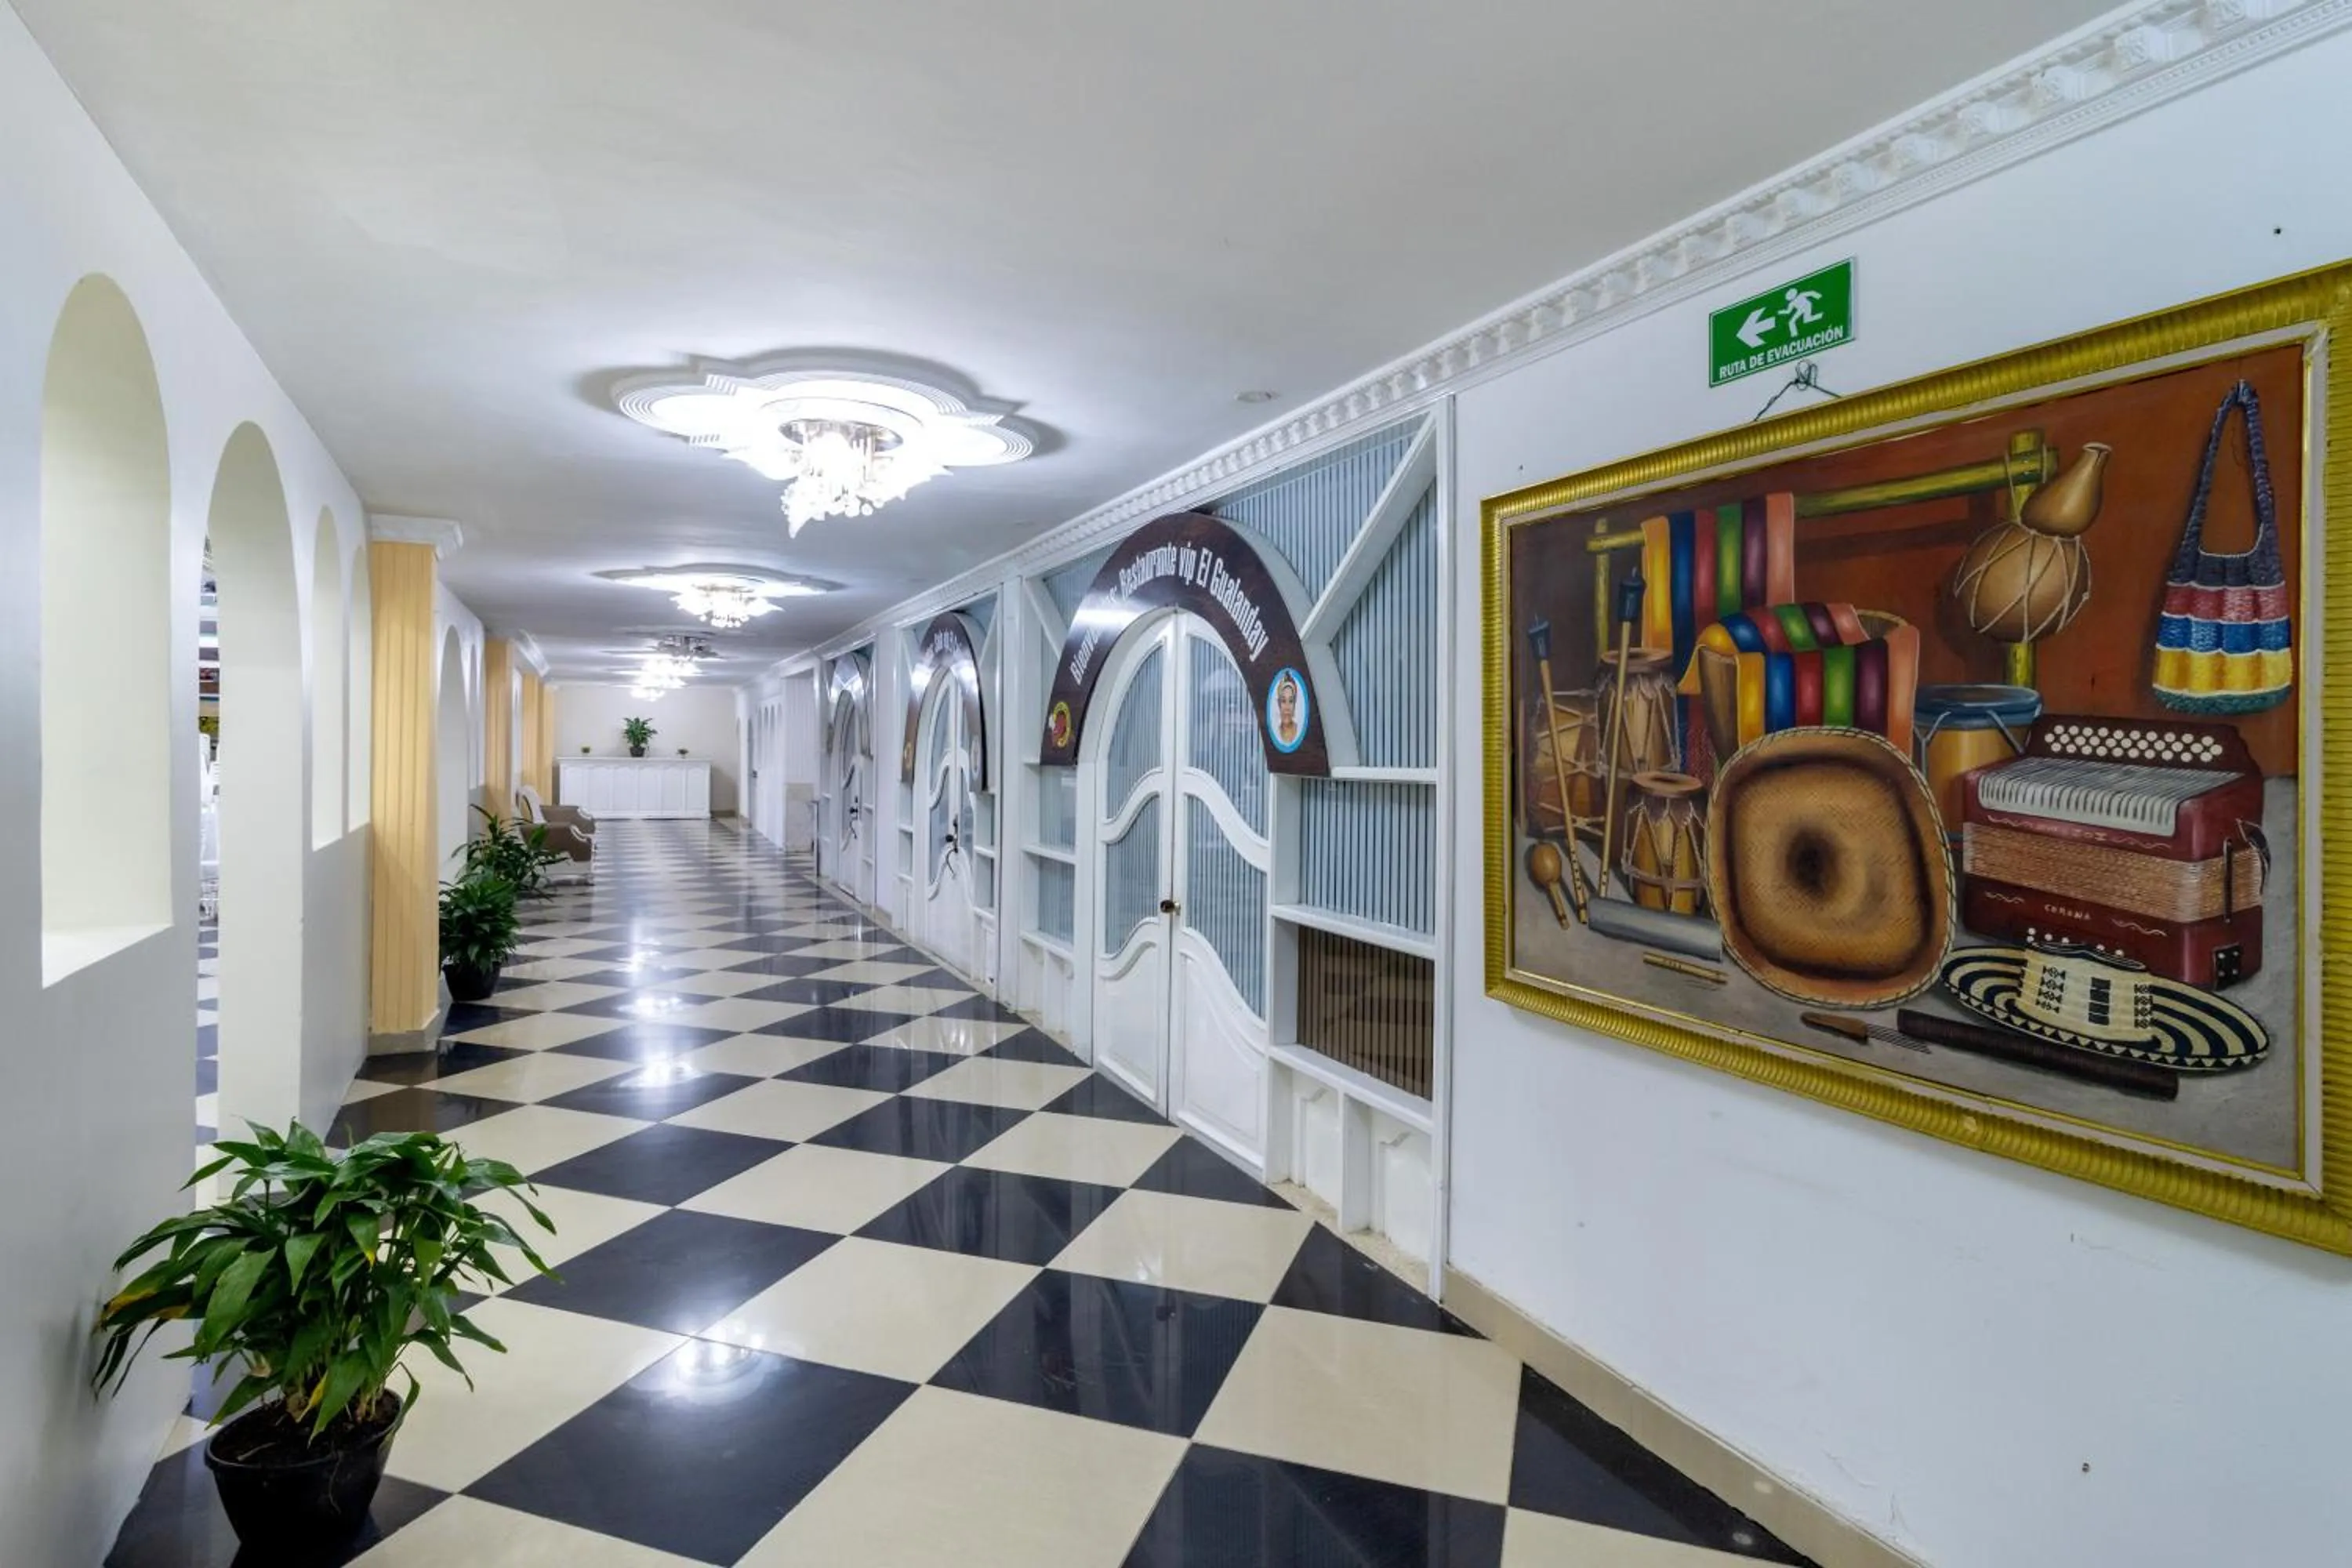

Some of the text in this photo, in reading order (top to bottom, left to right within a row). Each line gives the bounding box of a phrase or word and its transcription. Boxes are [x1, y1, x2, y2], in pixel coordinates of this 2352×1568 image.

[1719, 325, 1843, 379] RUTA DE EVACUACIÓN
[1119, 542, 1177, 602] Restaurante
[1178, 541, 1197, 586] vip
[1196, 546, 1213, 588] El
[1210, 557, 1270, 662] Gualanday
